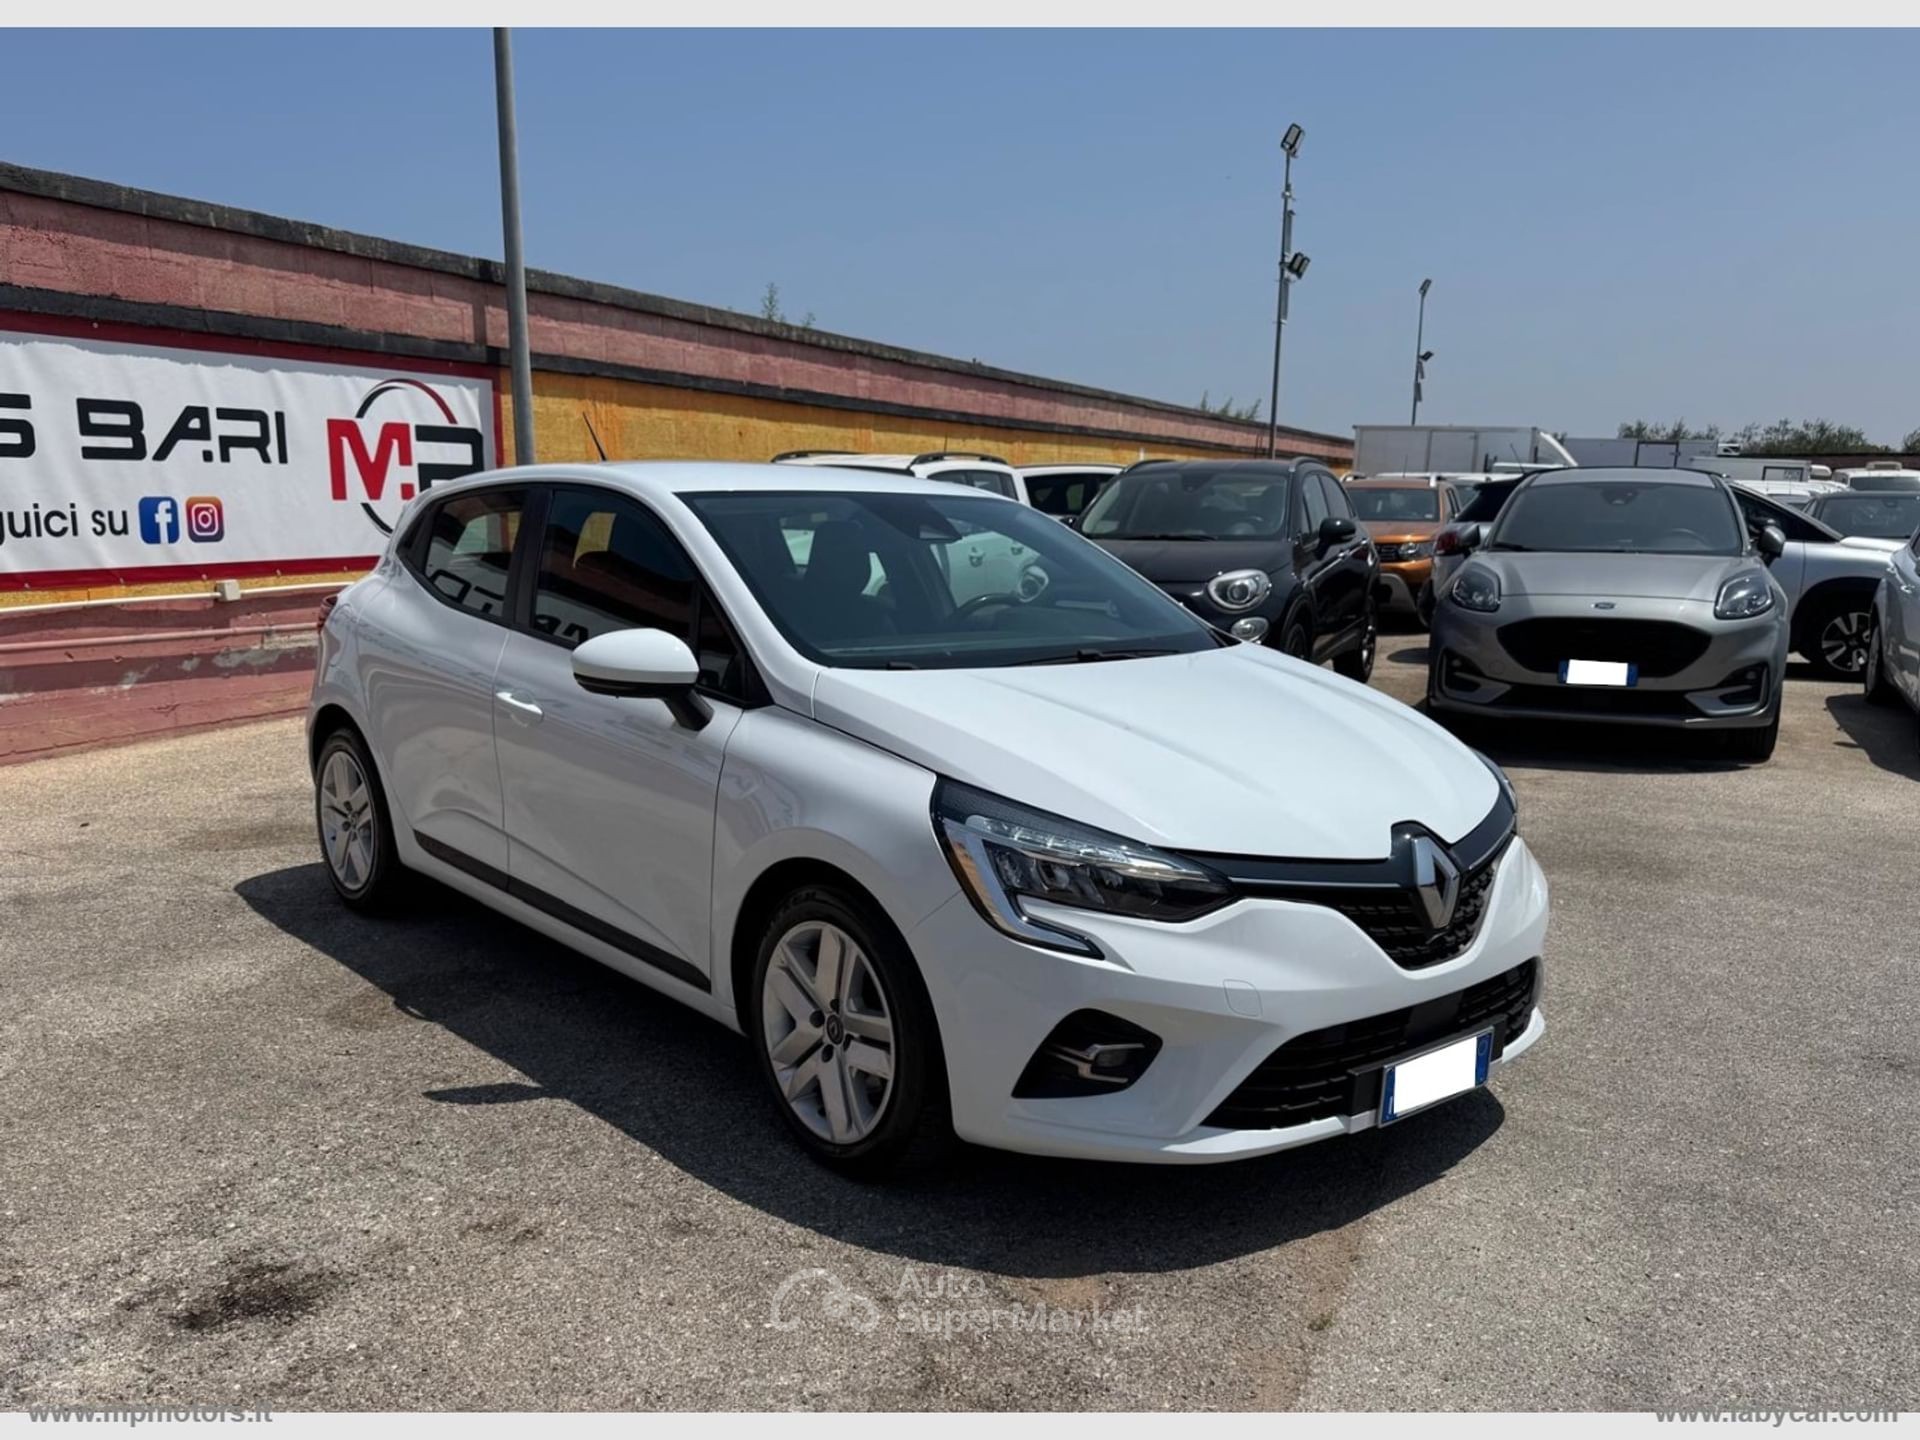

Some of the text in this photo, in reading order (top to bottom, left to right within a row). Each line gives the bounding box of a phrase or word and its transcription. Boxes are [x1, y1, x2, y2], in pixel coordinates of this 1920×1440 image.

[76, 397, 288, 464] BARI
[0, 503, 129, 547] uici su
